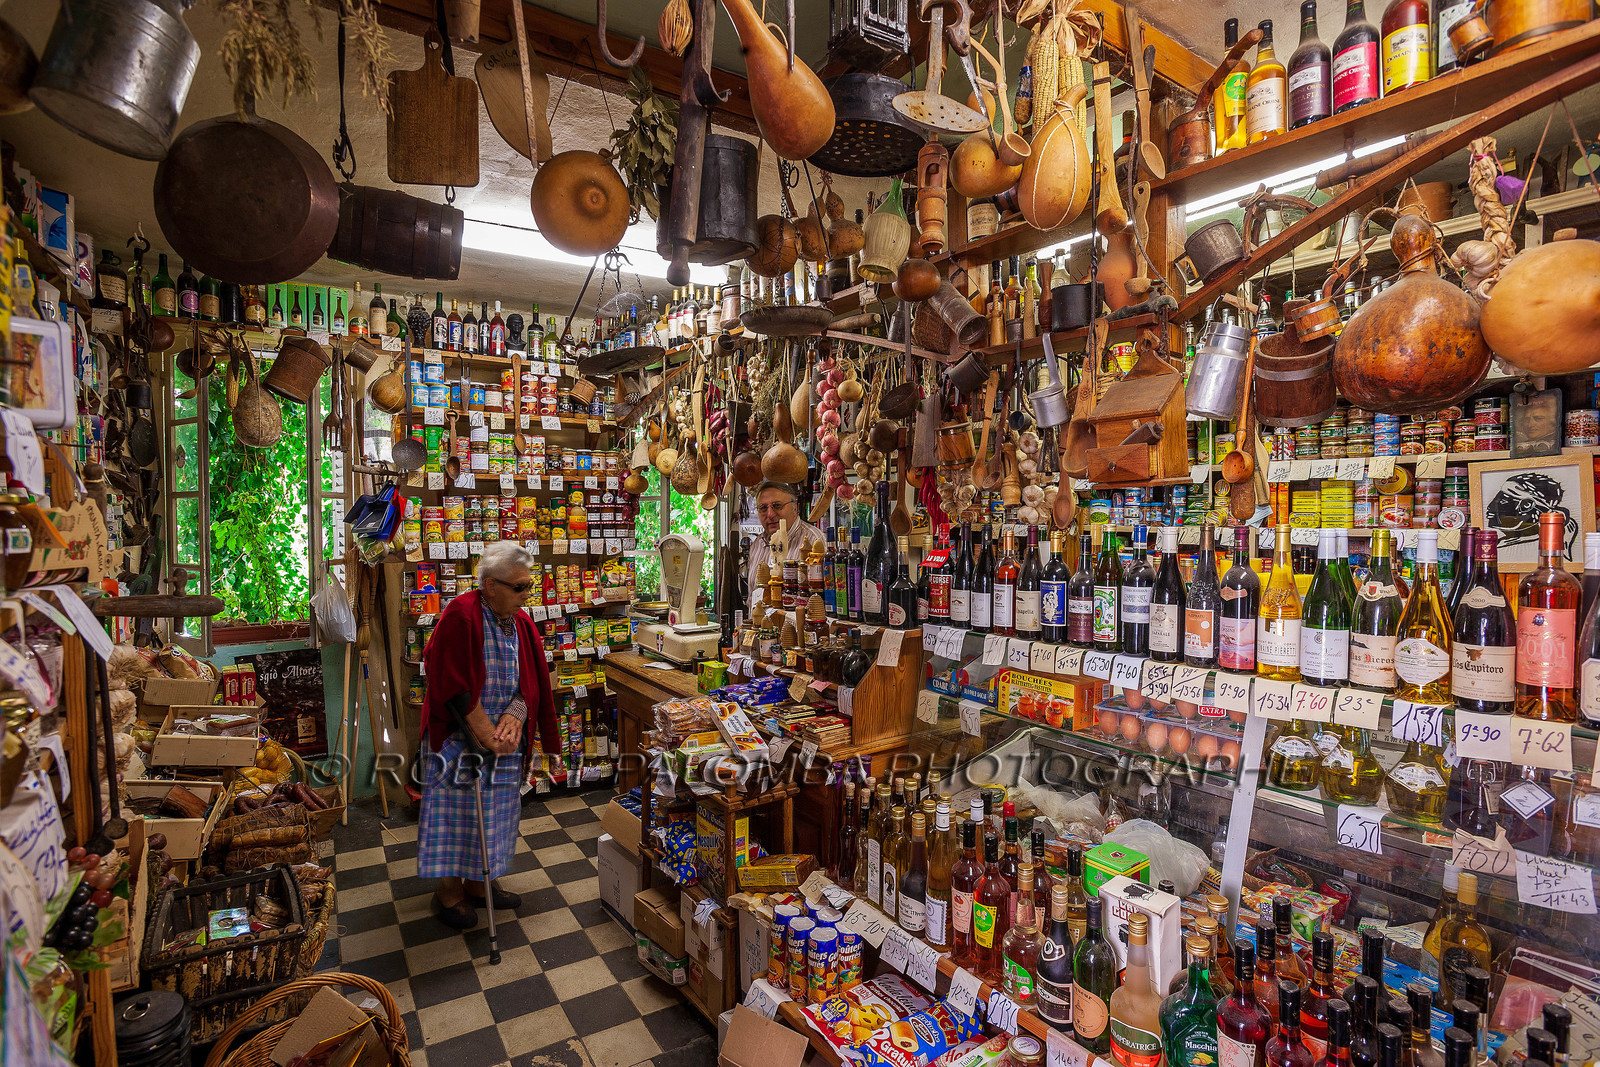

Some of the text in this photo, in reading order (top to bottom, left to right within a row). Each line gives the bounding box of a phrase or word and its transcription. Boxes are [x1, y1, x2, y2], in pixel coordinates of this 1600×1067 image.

[1465, 660, 1504, 674] Capitoro
[1011, 672, 1054, 688] BOUCHÉES
[1200, 706, 1224, 715] EXTRA
